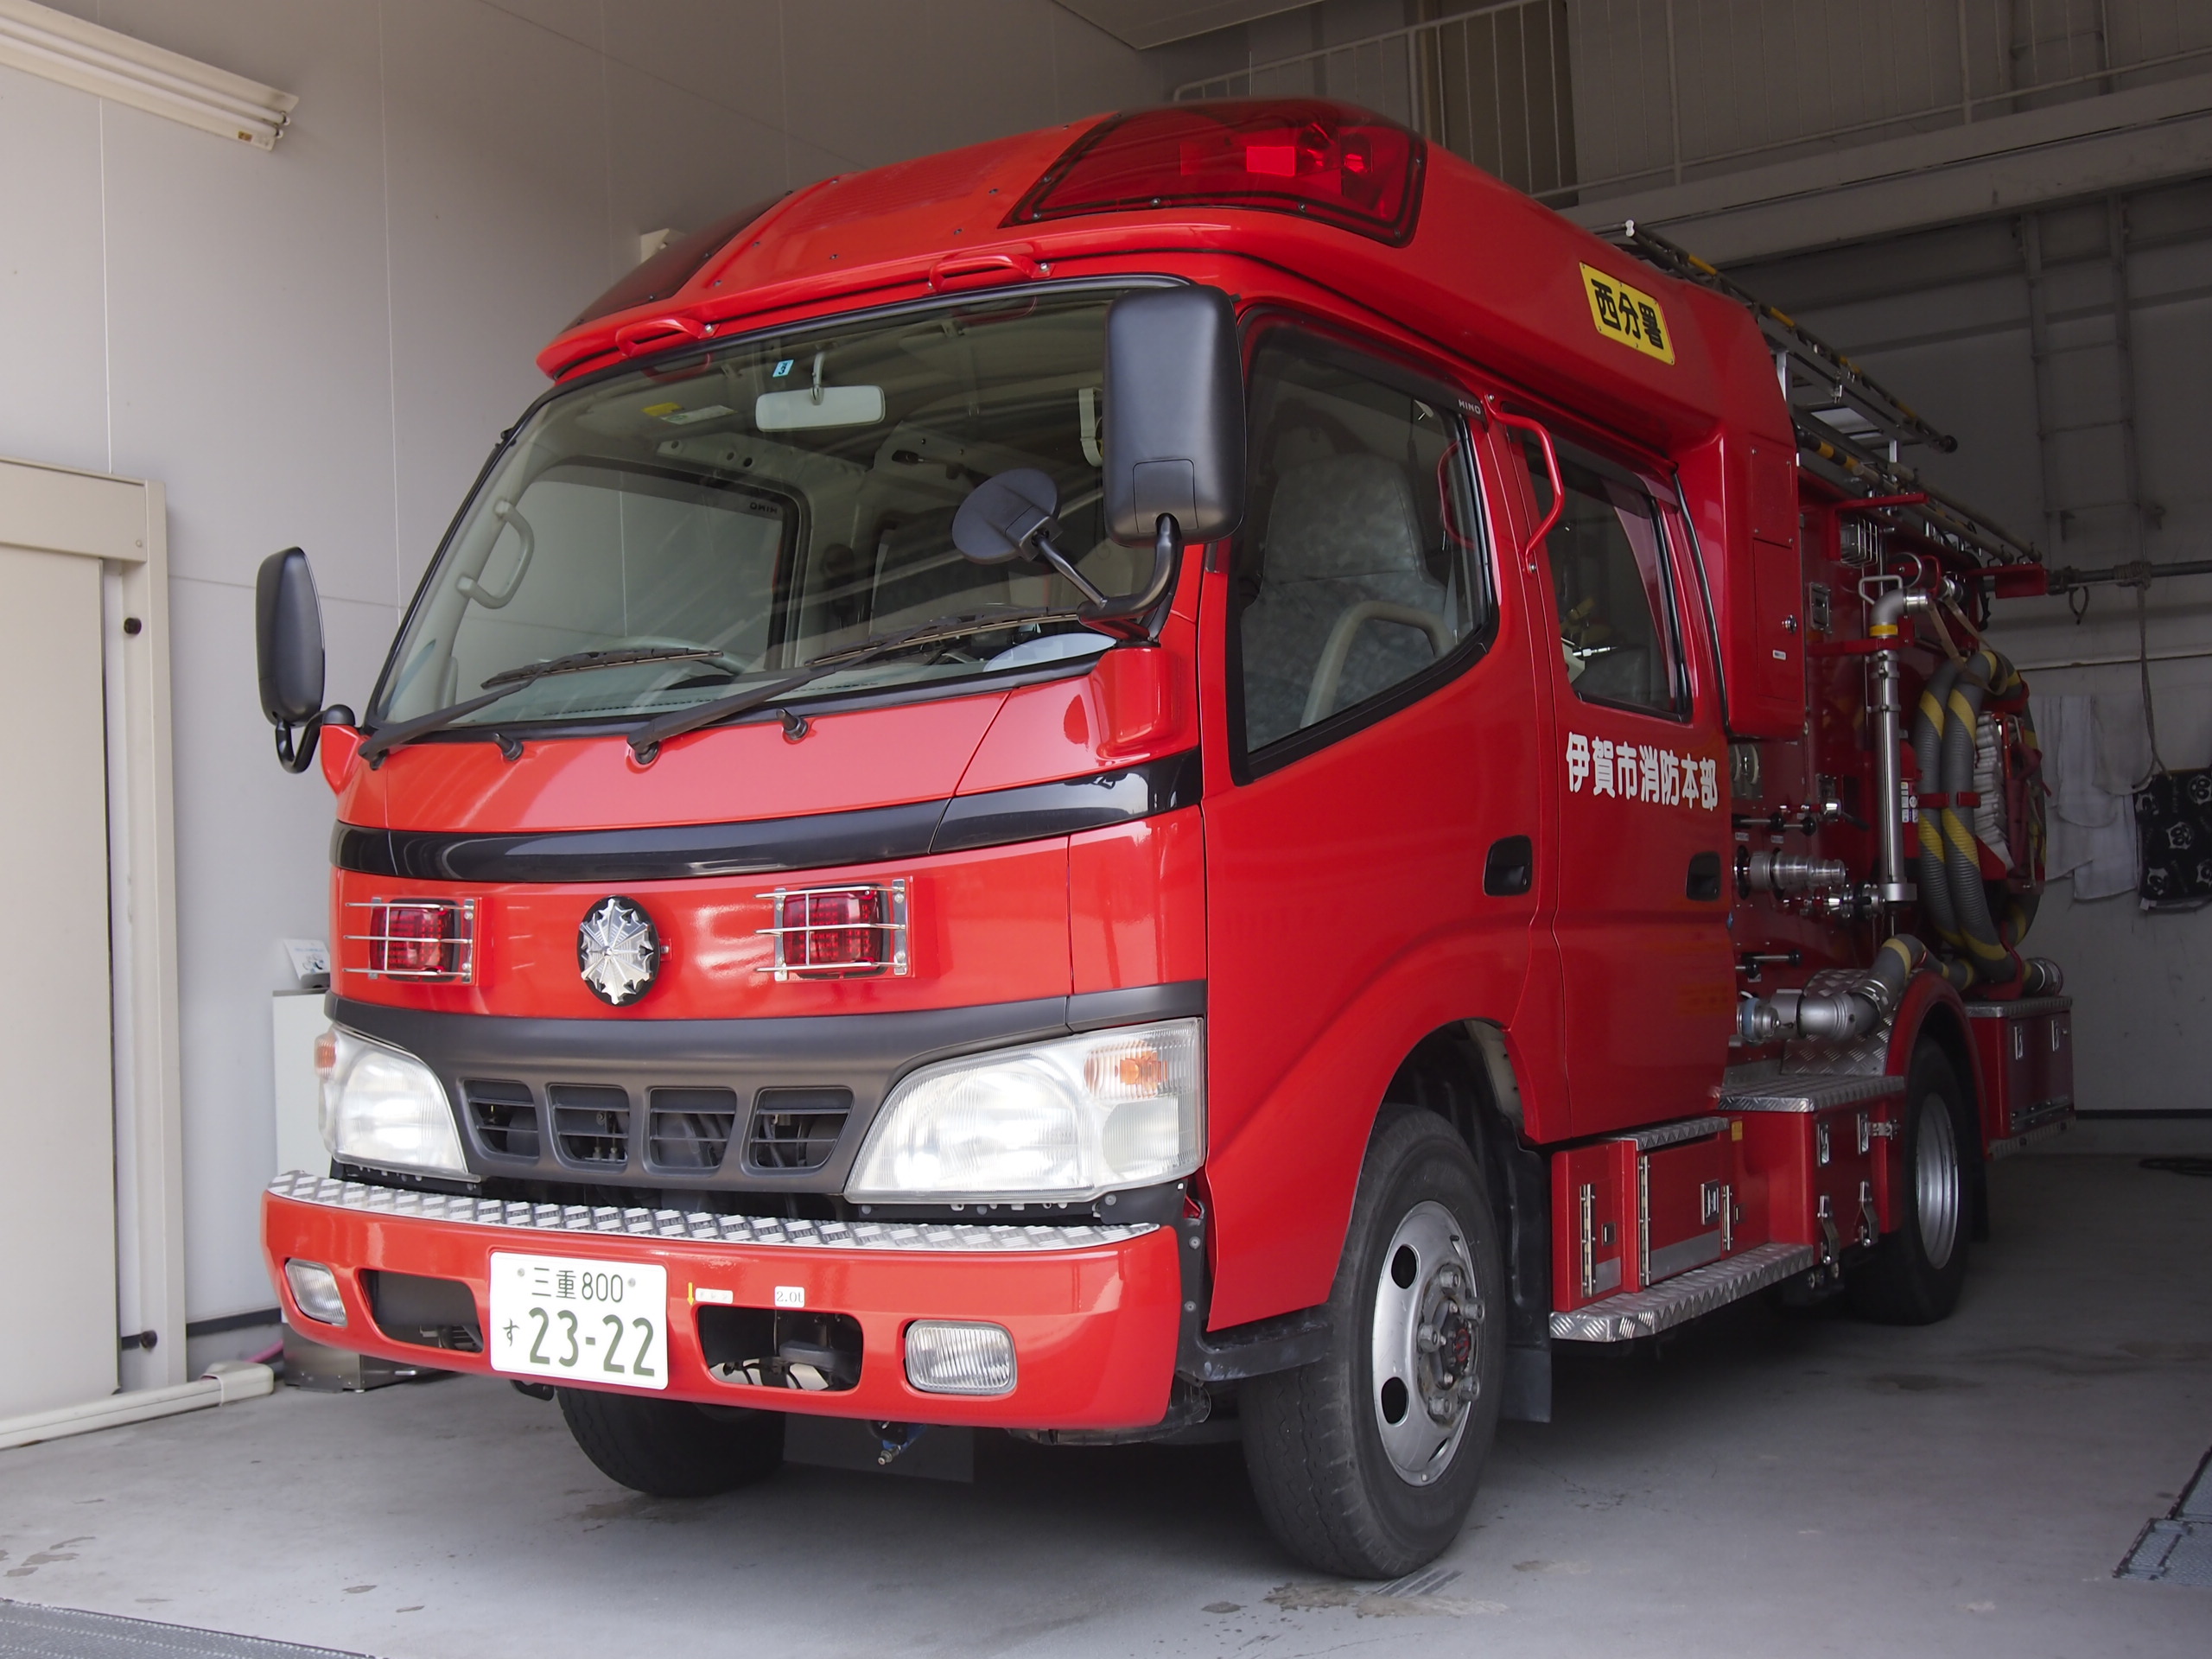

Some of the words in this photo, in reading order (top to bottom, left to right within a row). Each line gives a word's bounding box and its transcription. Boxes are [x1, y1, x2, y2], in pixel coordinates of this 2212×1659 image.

[1591, 278, 1664, 350] 西分署
[1458, 398, 1481, 416] HINO
[1566, 731, 1719, 812] 伊賀市消防本部
[502, 1318, 520, 1347] す
[529, 1306, 656, 1377] 23-22
